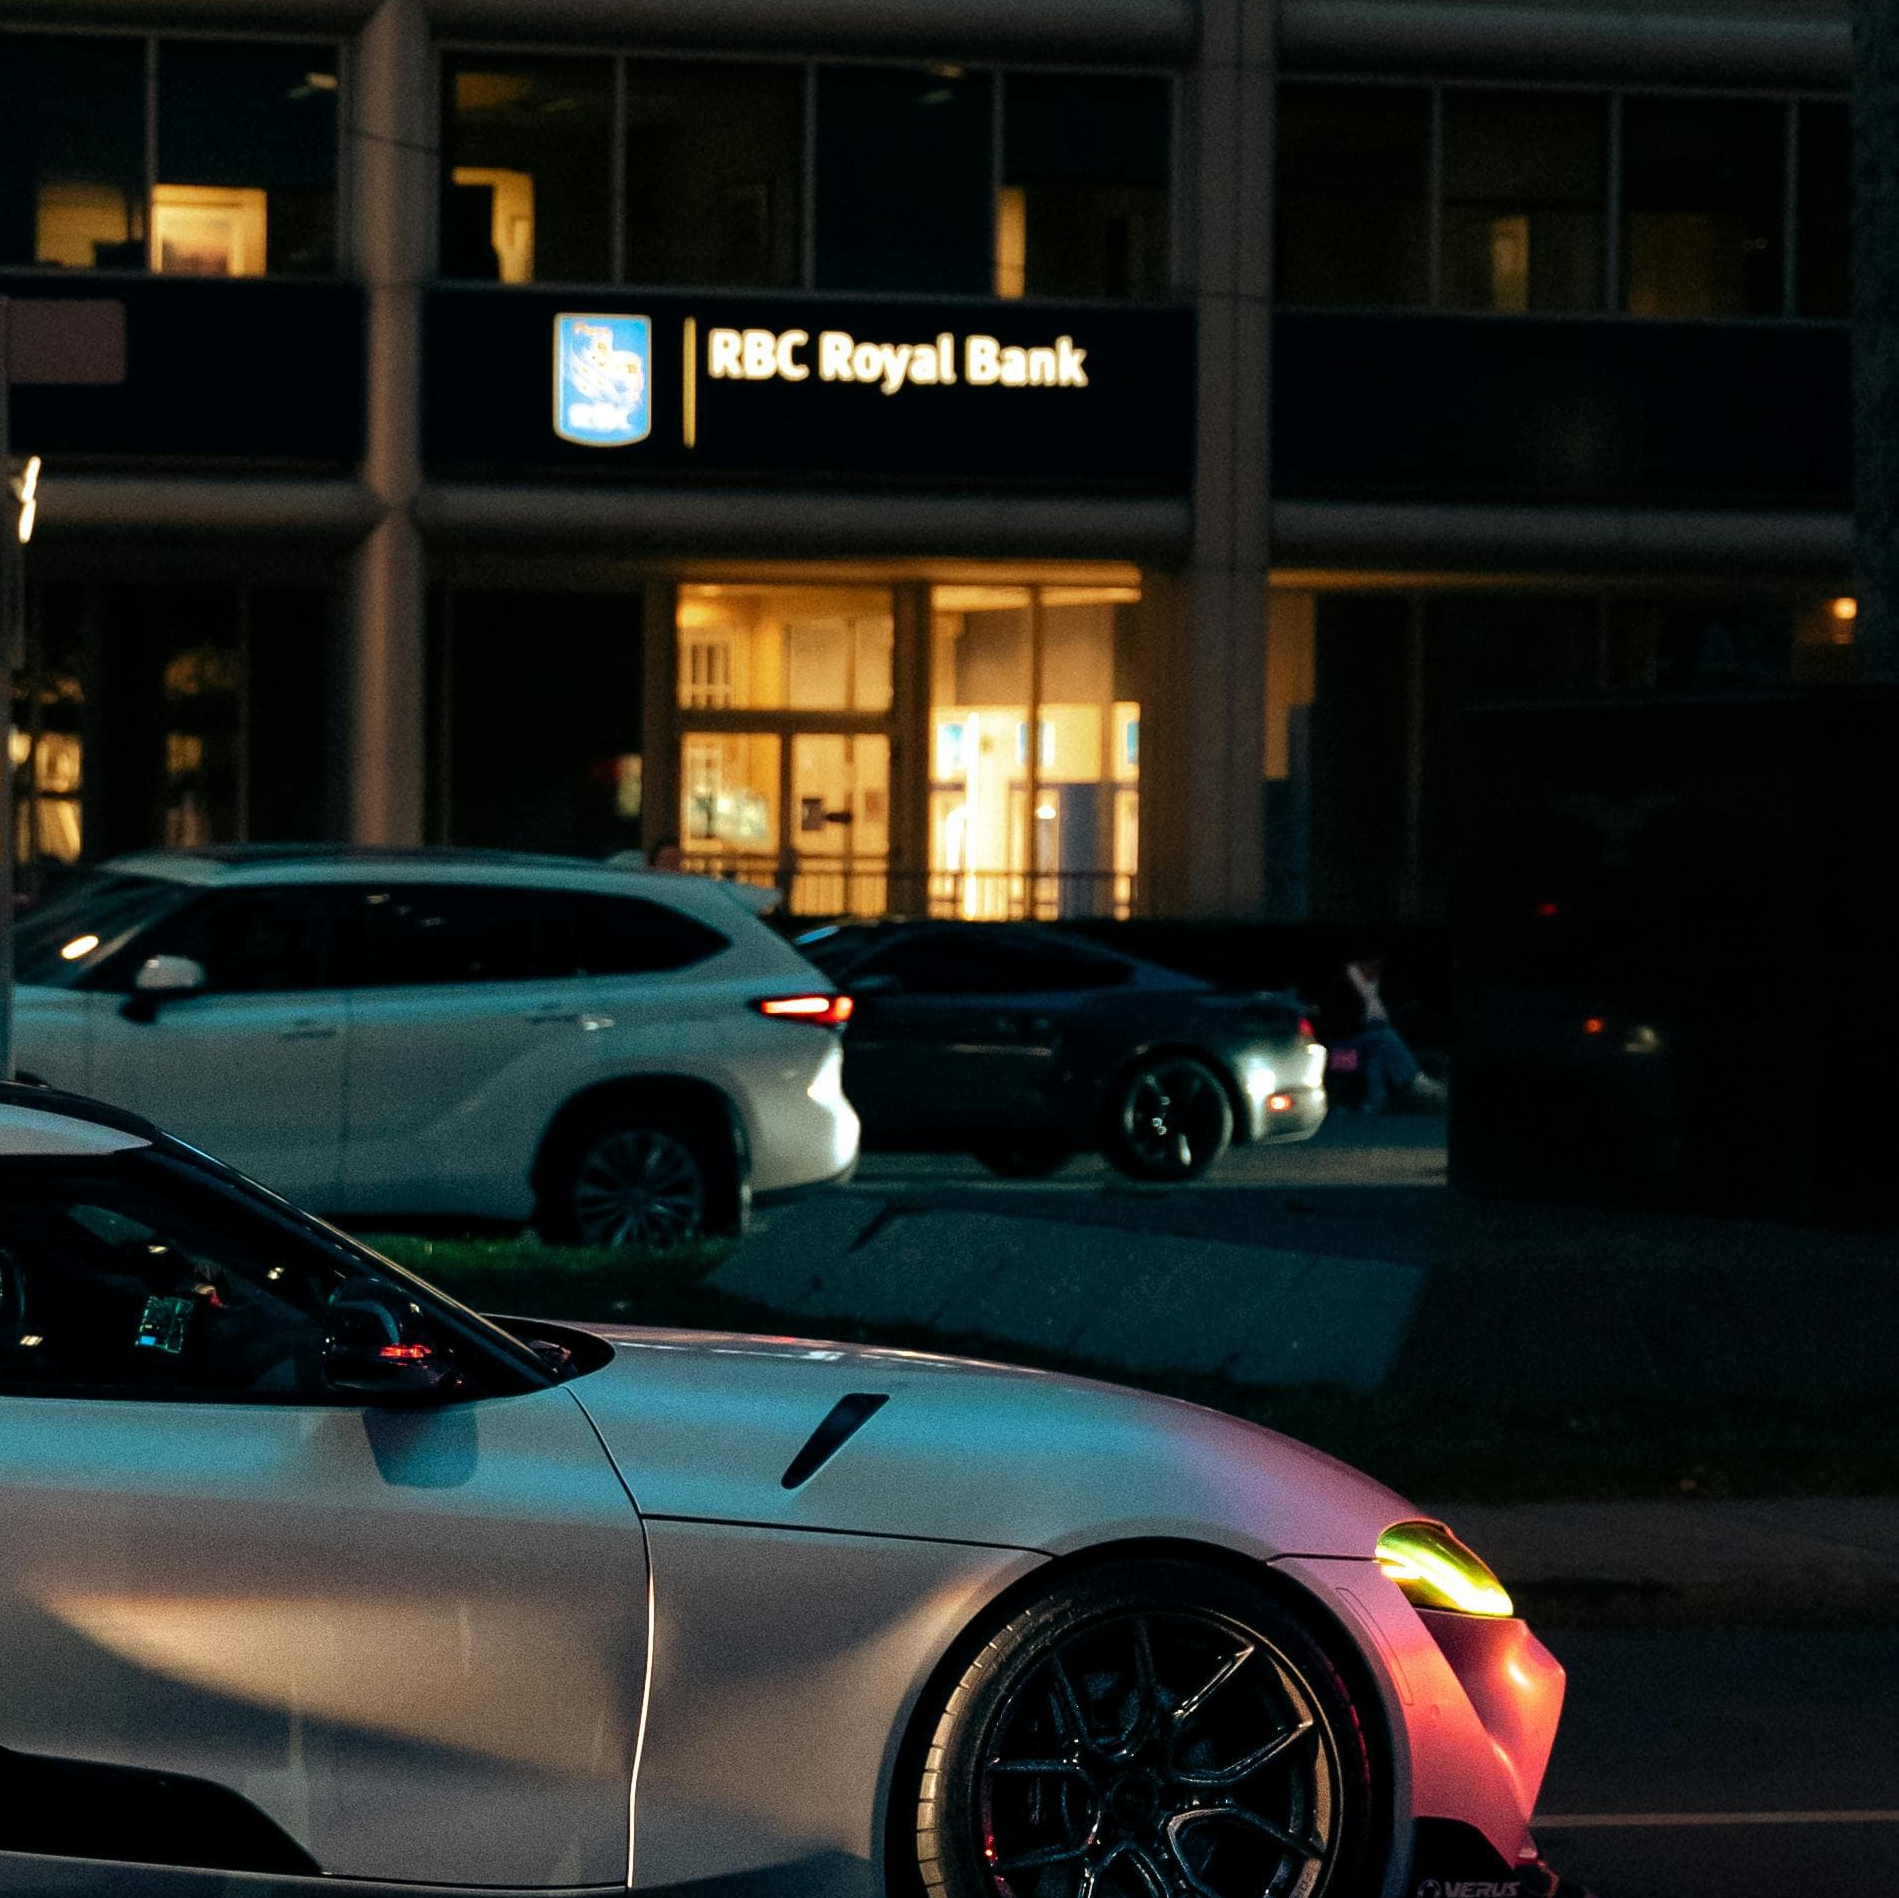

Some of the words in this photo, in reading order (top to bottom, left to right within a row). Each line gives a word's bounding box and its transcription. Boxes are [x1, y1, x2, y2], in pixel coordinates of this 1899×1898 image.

[708, 328, 809, 381] RBC
[819, 331, 957, 395] Royal
[965, 334, 1089, 387] Bank
[1443, 1880, 1521, 1898] VERUS
